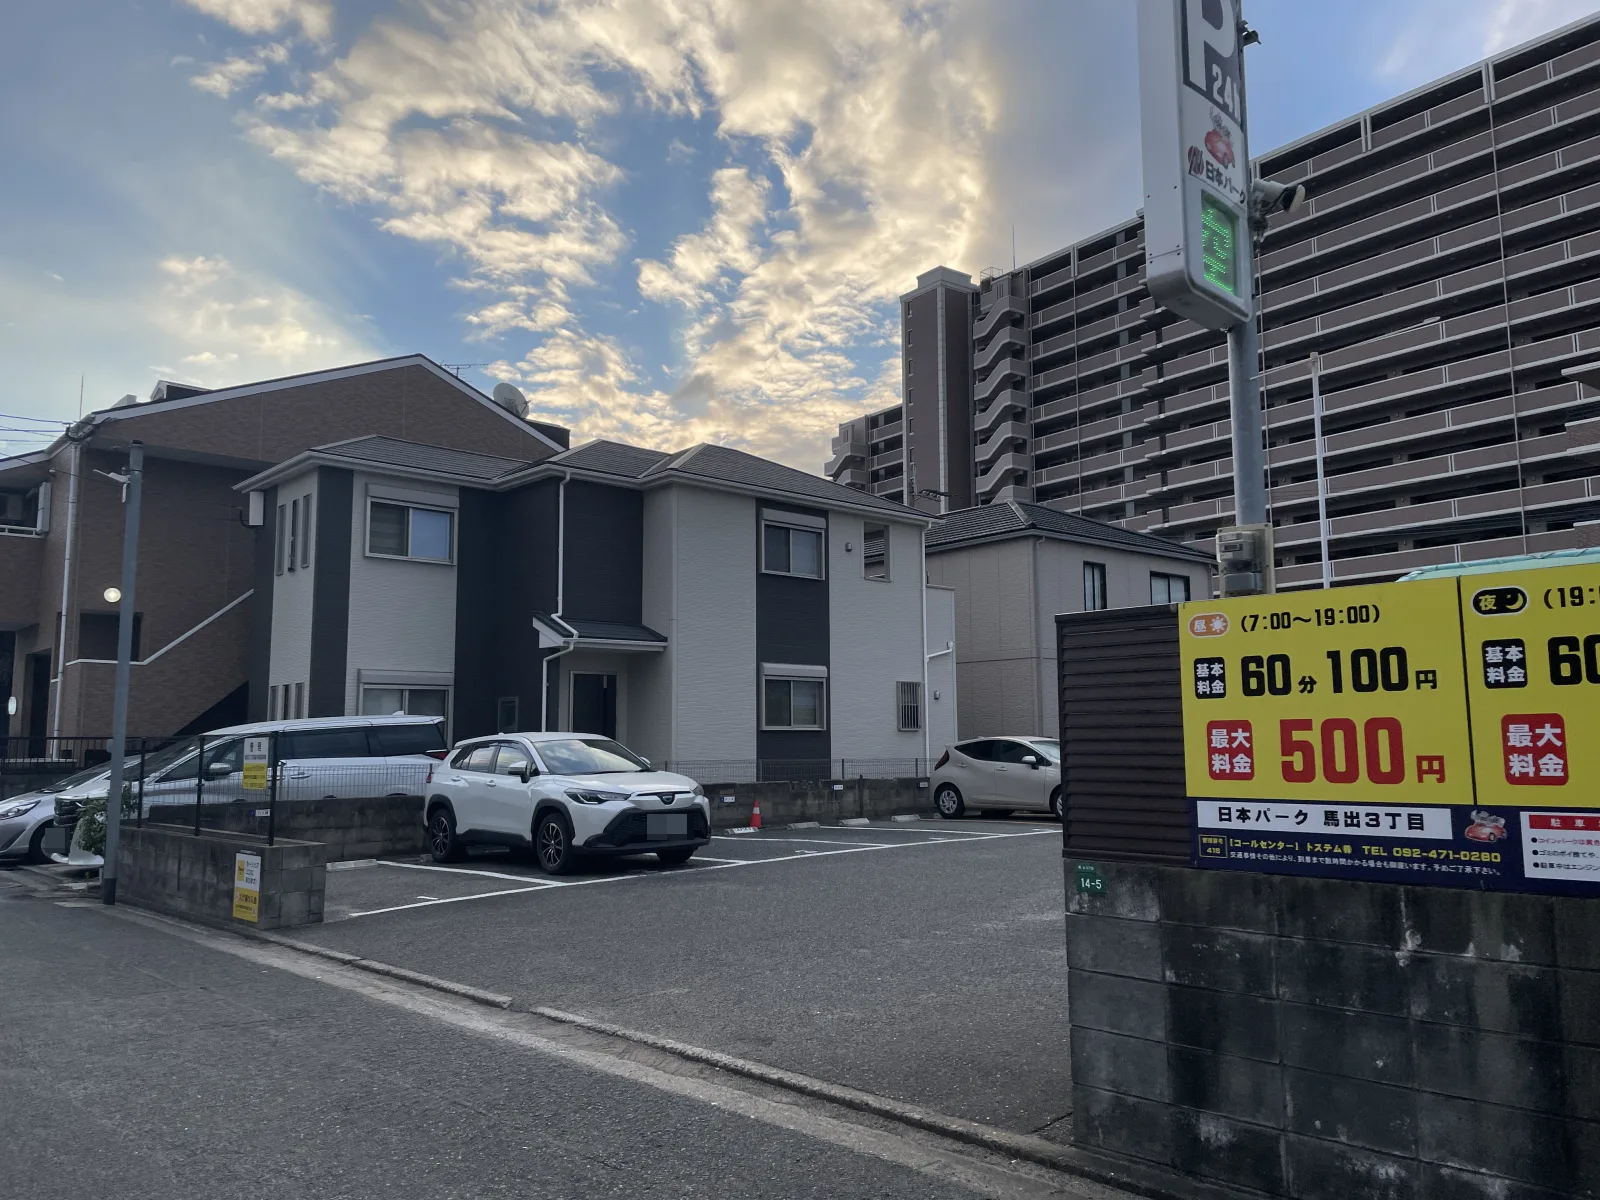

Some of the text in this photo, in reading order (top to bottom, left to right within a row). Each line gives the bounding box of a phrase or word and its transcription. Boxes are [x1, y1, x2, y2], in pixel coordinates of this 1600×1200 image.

[1206, 160, 1246, 204] 日本パーク
[1479, 594, 1497, 610] 夜
[1543, 585, 1600, 609] (19:
[1485, 645, 1523, 663] 基本
[1196, 663, 1224, 677] 基本
[1486, 665, 1526, 684] 料金
[1197, 679, 1225, 695] 料金
[1210, 728, 1251, 749] 最大
[1507, 723, 1563, 748] 最大
[1211, 752, 1252, 774] 料金
[1508, 752, 1565, 777] 料金
[1218, 806, 1425, 831] 日本パーク 馬出3丁目
[1362, 845, 1388, 857] TEL
[1393, 847, 1501, 863] 092-471-0280
[1080, 877, 1102, 889] 14-5
